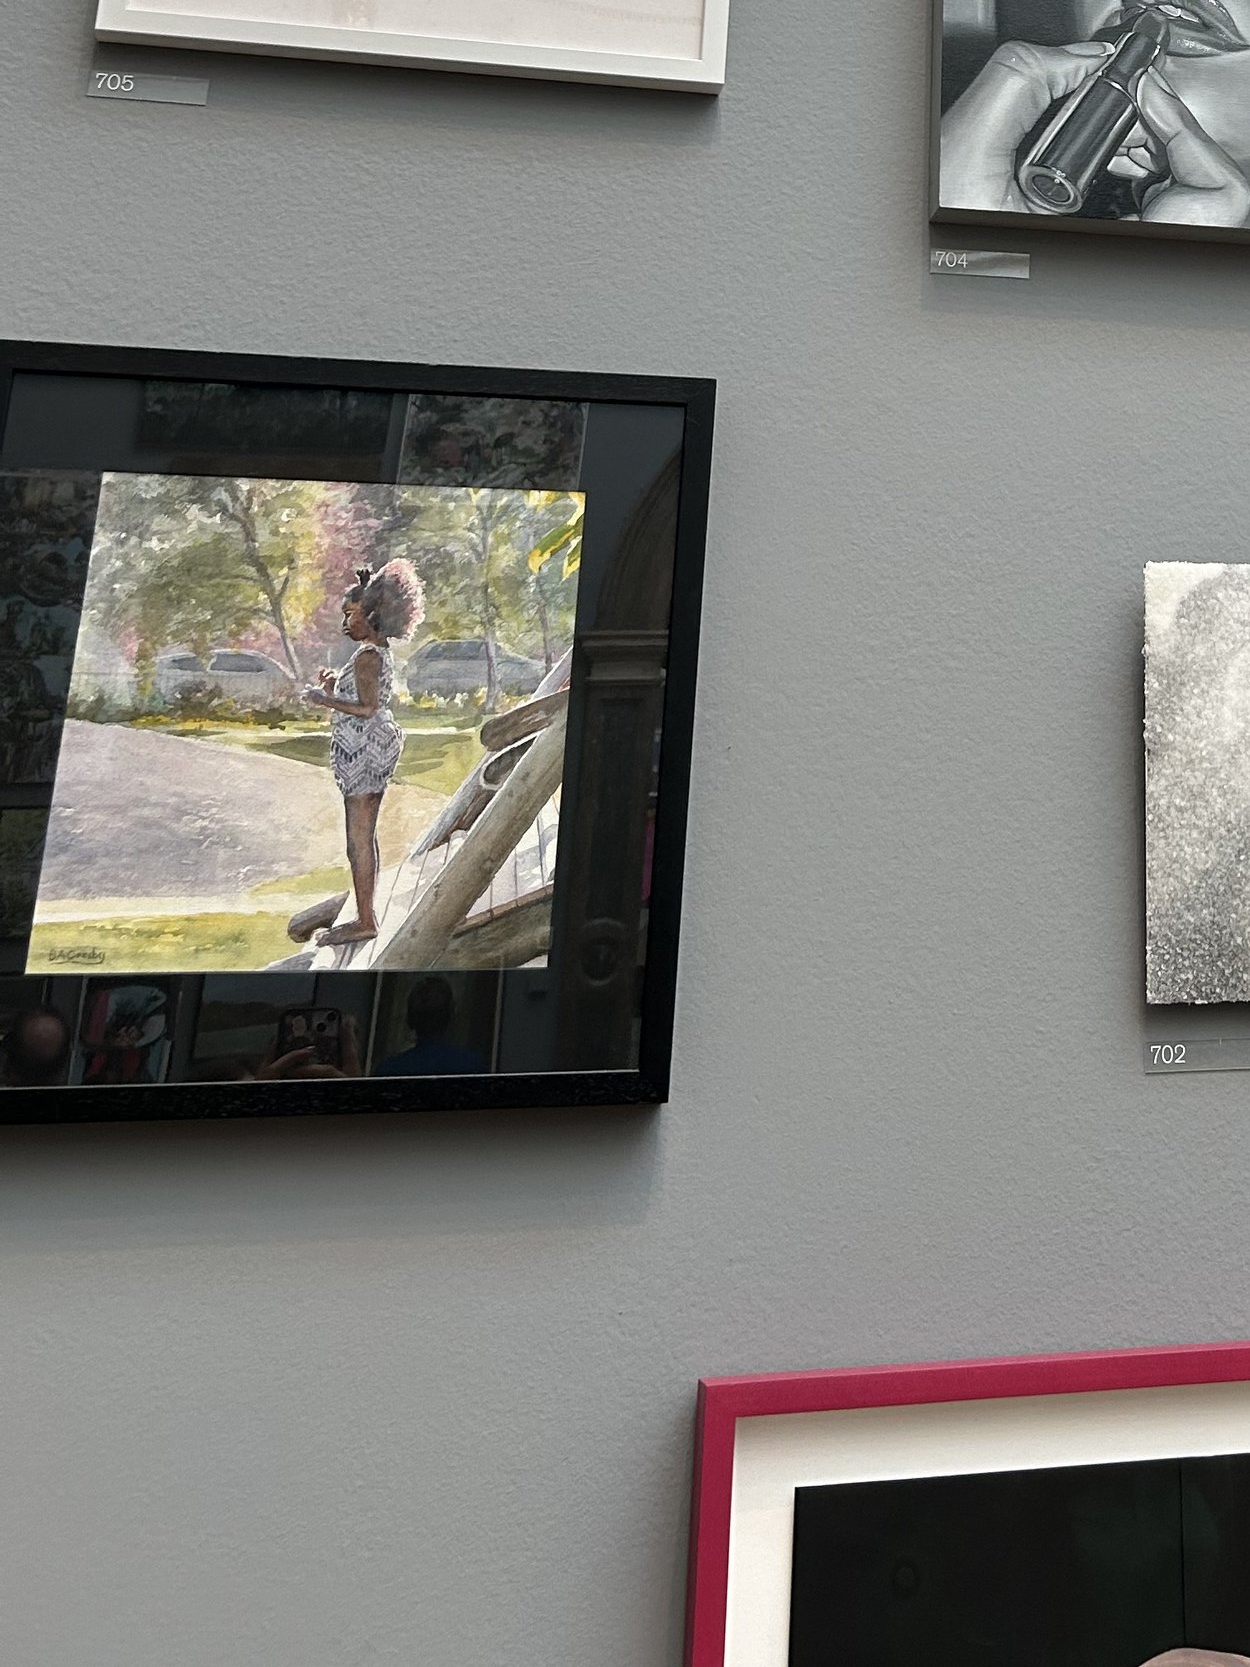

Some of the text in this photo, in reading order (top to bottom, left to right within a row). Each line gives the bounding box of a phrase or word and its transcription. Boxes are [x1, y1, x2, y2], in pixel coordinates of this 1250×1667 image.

[95, 72, 134, 91] 705
[935, 251, 969, 268] 704
[1150, 1044, 1186, 1064] 702
